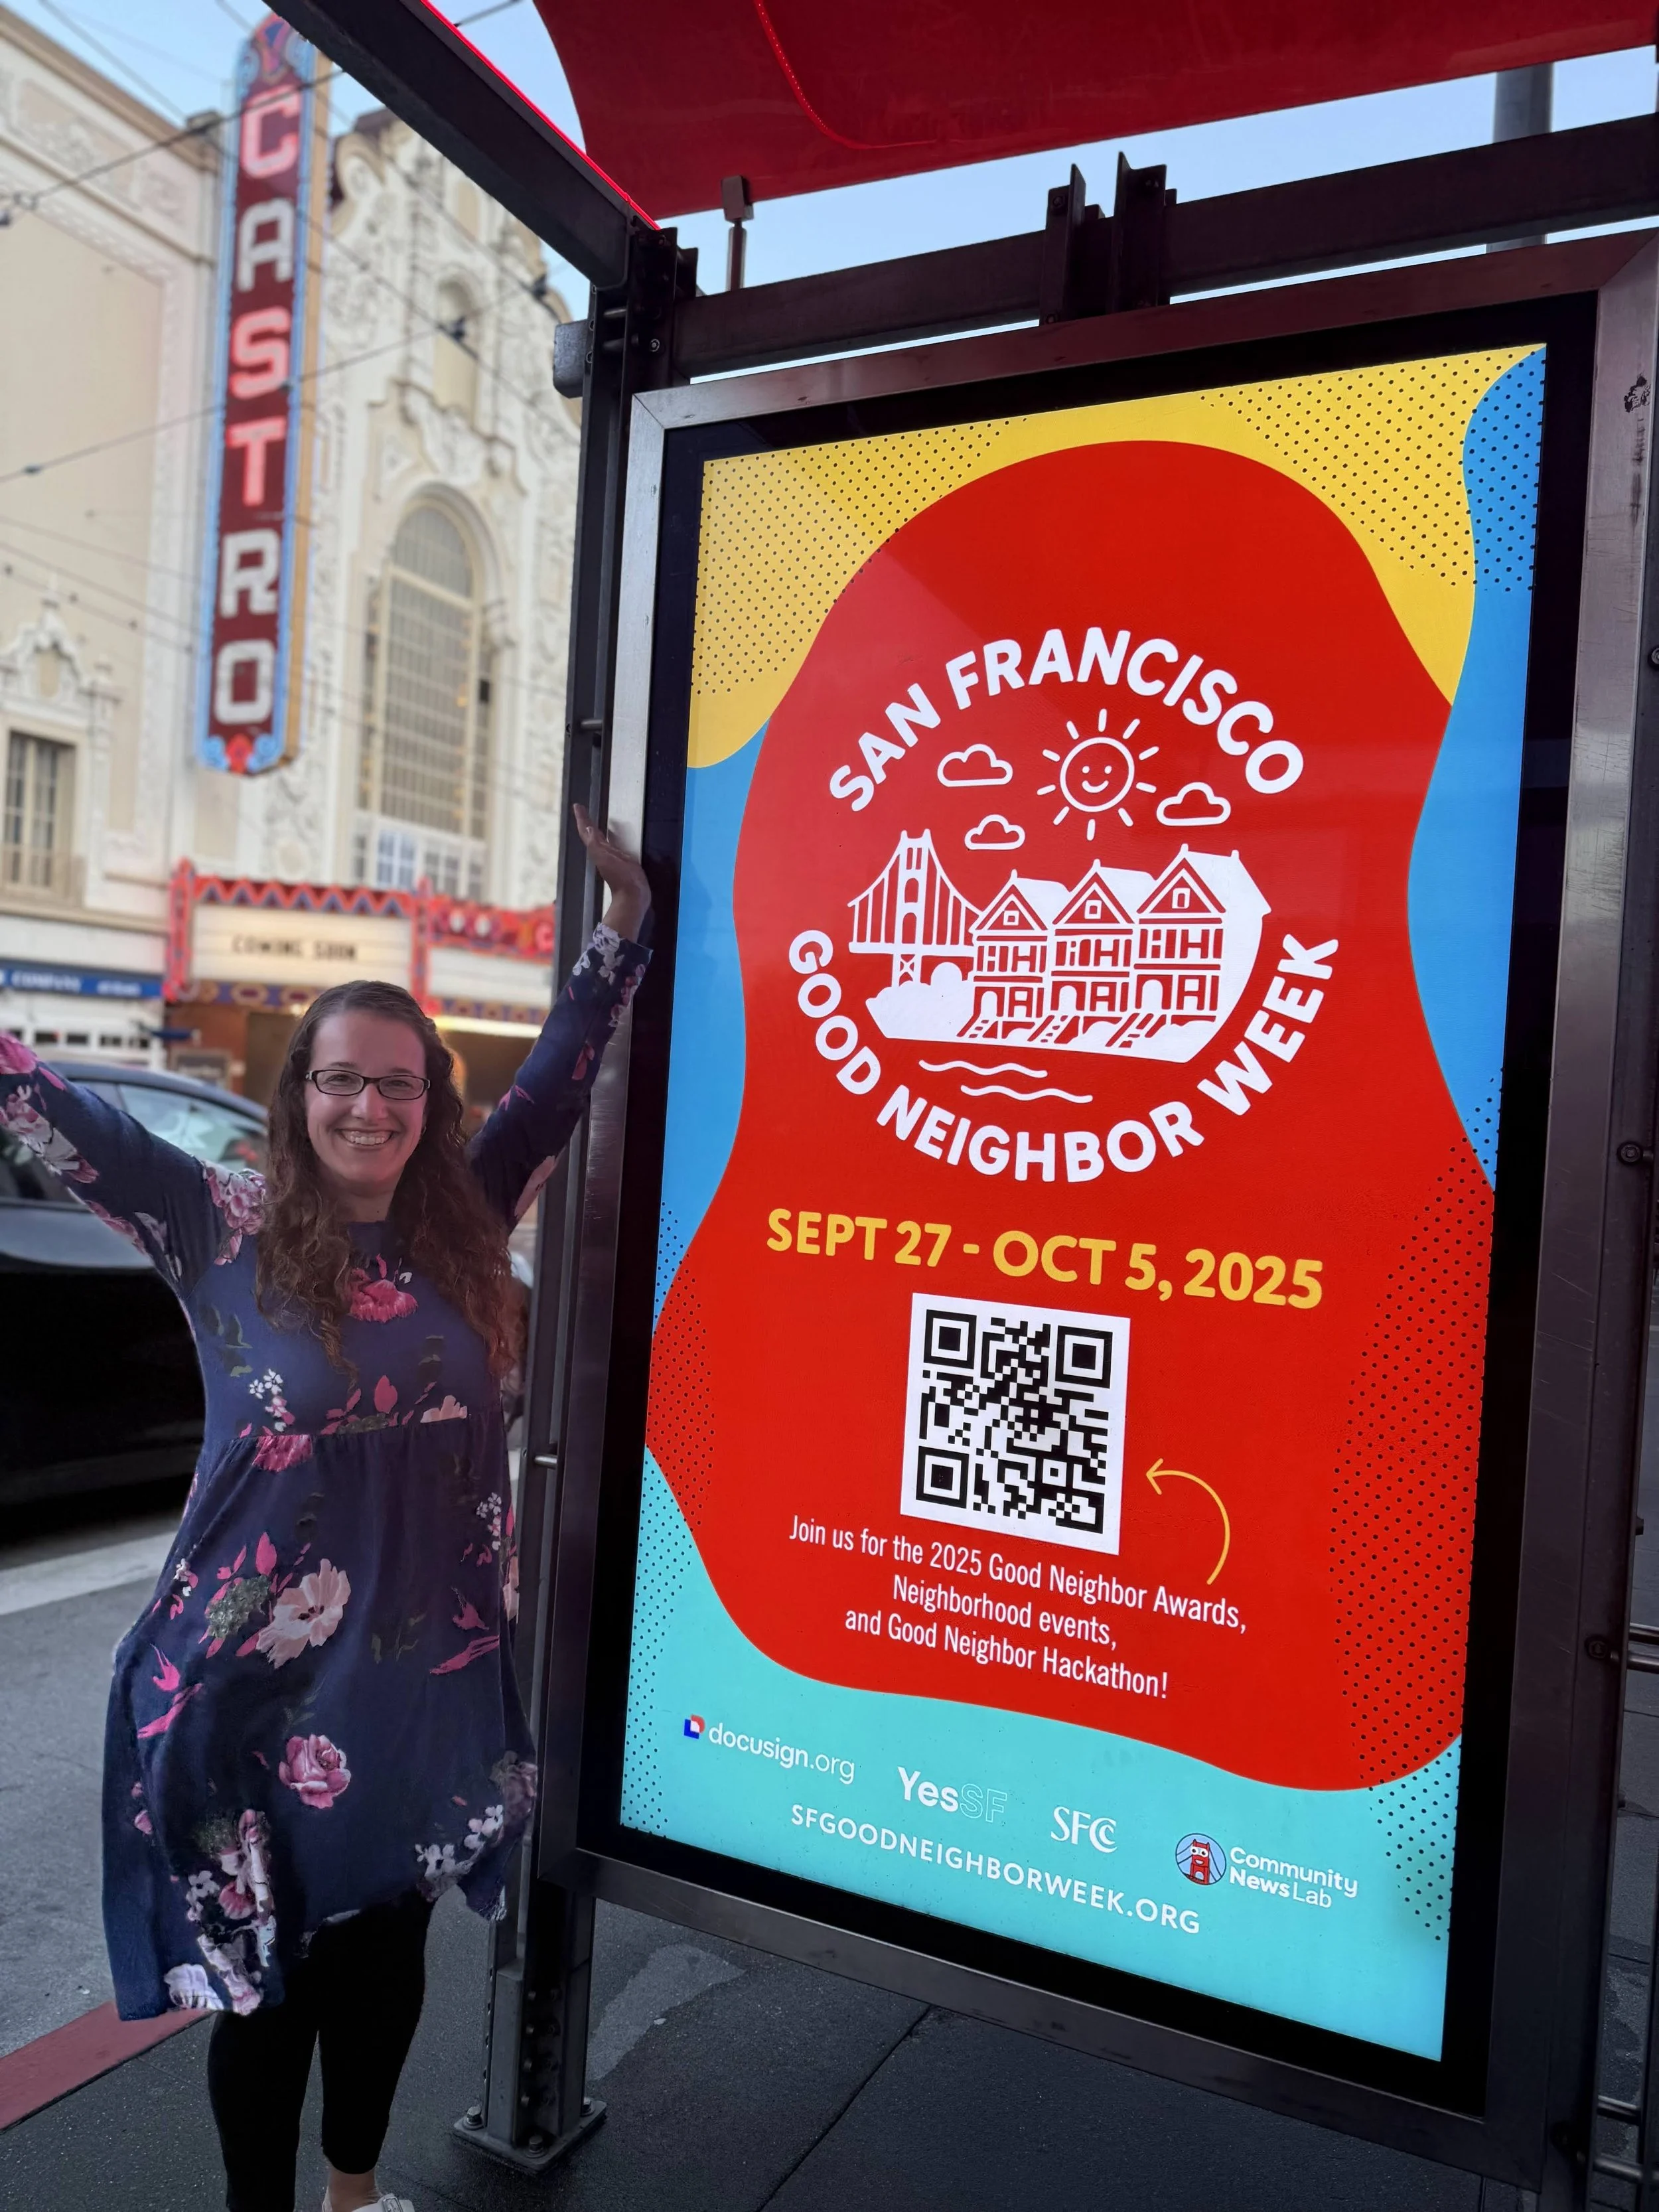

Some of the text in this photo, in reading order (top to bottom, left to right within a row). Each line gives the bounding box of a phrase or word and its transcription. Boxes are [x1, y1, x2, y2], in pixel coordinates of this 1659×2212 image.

[214, 85, 299, 725] CASTRO
[830, 626, 1303, 812] SAN FRANCISCO
[789, 930, 1338, 1183] GOOD NEIGHBOR WEEK
[767, 1209, 887, 1260] SEPT
[897, 1221, 951, 1266] 27
[993, 1231, 1116, 1285] OCT
[1125, 1244, 1173, 1301] 5,
[1185, 1250, 1323, 1309] 2025
[790, 1515, 1246, 1634] Join us for the 2025 Good Neighbor Awards,
[894, 1575, 1116, 1651] Neighborhood events,
[845, 1611, 1167, 1699] and Good Neighbor Hackathon!
[709, 1723, 855, 1785] docusign.org
[898, 1766, 1007, 1822] YesSF
[792, 1805, 1200, 1934] SFGOODNEIGHBORWEEK.ORG
[1230, 1847, 1358, 1899] Community
